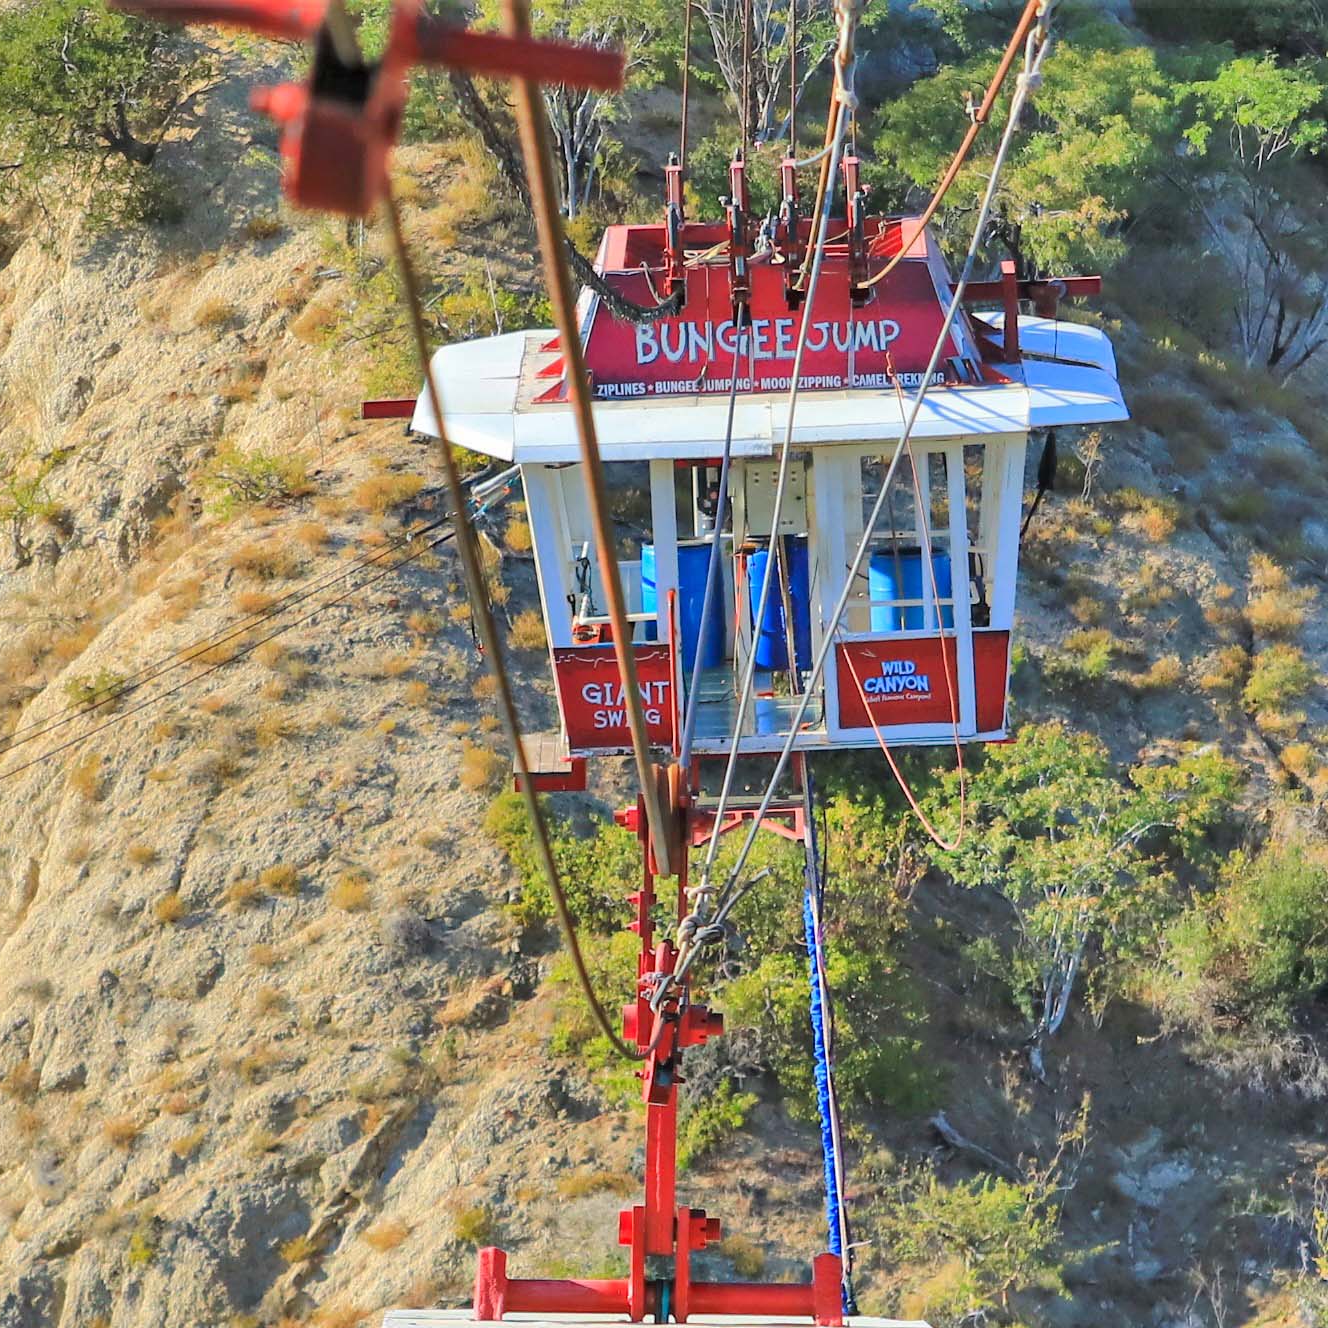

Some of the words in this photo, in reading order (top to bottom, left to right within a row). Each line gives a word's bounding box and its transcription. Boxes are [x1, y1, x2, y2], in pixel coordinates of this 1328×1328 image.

[635, 318, 796, 365] BUNGEE
[804, 319, 900, 353] JUMP
[597, 382, 646, 397] ZIPLINES
[655, 380, 700, 394] BUNGEE
[701, 378, 751, 392] JUMPNG
[761, 377, 794, 390] MOON
[798, 376, 842, 389] ZIPPING
[852, 373, 889, 387] CAMEL
[891, 372, 945, 386] REKKNG
[880, 660, 916, 675] WILD
[863, 675, 929, 693] CANYON
[593, 708, 662, 729] SWIG
